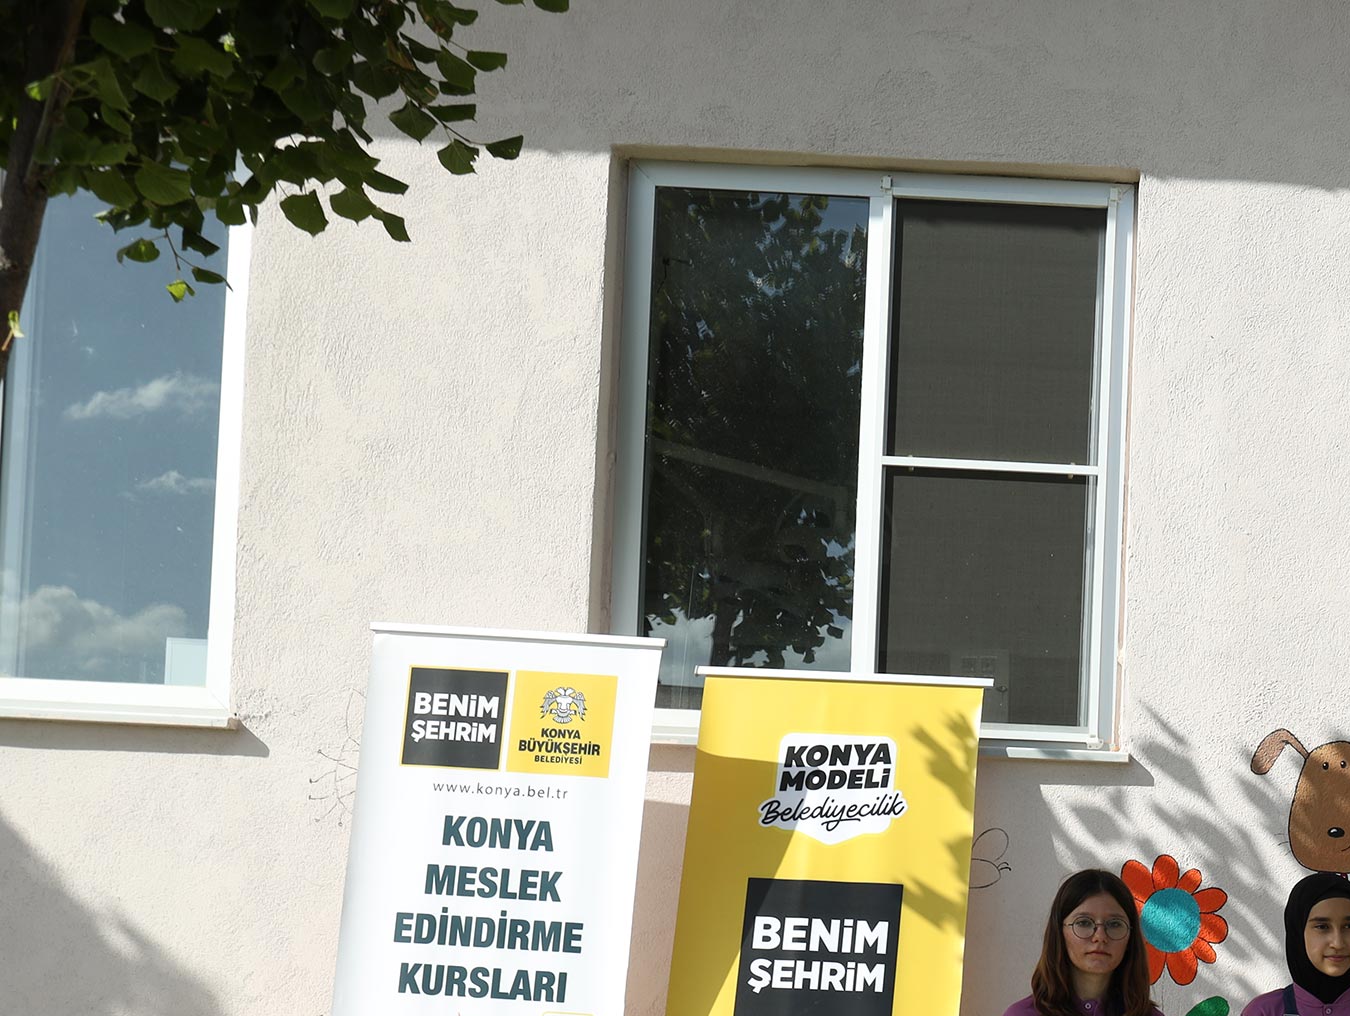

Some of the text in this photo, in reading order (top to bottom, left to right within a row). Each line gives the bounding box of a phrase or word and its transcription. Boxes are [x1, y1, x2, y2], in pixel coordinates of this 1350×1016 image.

[518, 739, 601, 757] BÜYÜKŞEHİR
[540, 728, 581, 740] KONYA
[534, 754, 583, 765] BELEDİYESİ
[783, 743, 891, 767] KONYA
[432, 782, 568, 800] www.konya.bel.tr
[759, 793, 905, 832] Belediyecilik
[441, 814, 554, 852] KONYA
[424, 863, 564, 903] MESLEK
[393, 906, 584, 954] EDİNDİRME
[397, 962, 568, 1004] KURSLARI
